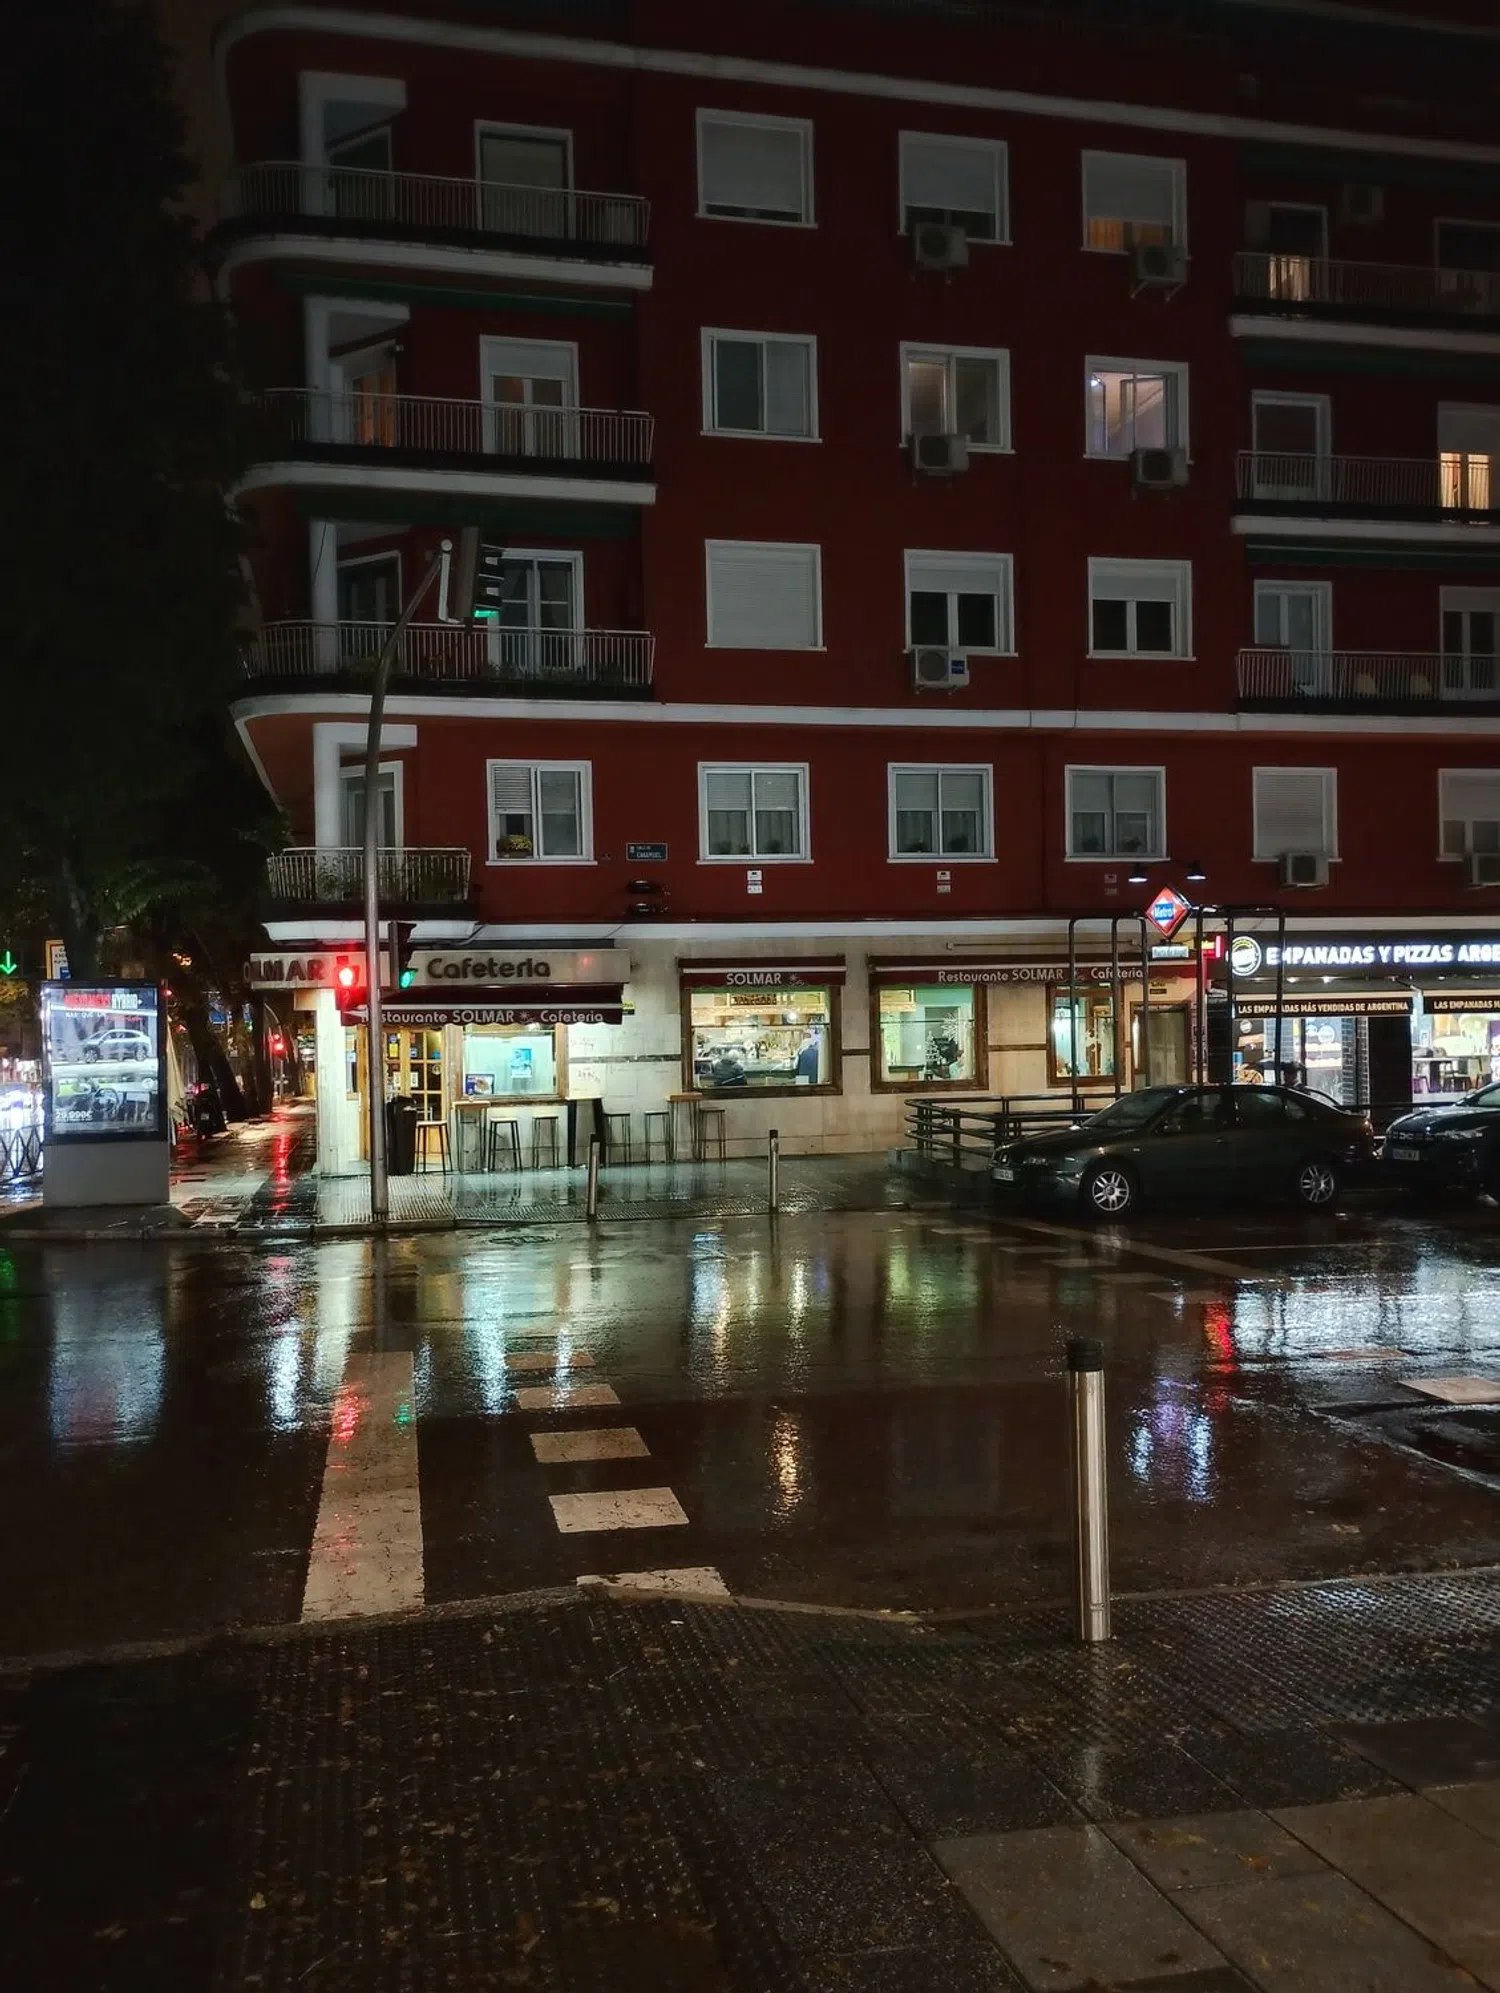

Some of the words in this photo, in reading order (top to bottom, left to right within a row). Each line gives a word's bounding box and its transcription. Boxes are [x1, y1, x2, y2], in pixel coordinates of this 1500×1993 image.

[1154, 906, 1173, 918] Metro
[1378, 945, 1392, 963] Y
[1393, 944, 1454, 963] PIZZAS
[726, 972, 782, 985] SOLMAR
[938, 971, 1009, 982] Restaurante
[1012, 968, 1064, 981] SOLMAR
[1238, 1005, 1252, 1014] LAS
[1301, 1002, 1316, 1012] MÁS
[1317, 1002, 1354, 1012] VENDIDAS
[1355, 1003, 1365, 1011] DE
[1367, 1001, 1409, 1011] ARGENTINA
[1433, 1000, 1448, 1010] LAS
[1449, 1000, 1493, 1009] EMPANADAS
[452, 1010, 514, 1023] SOLMAR
[540, 1010, 603, 1022] Cafeteria
